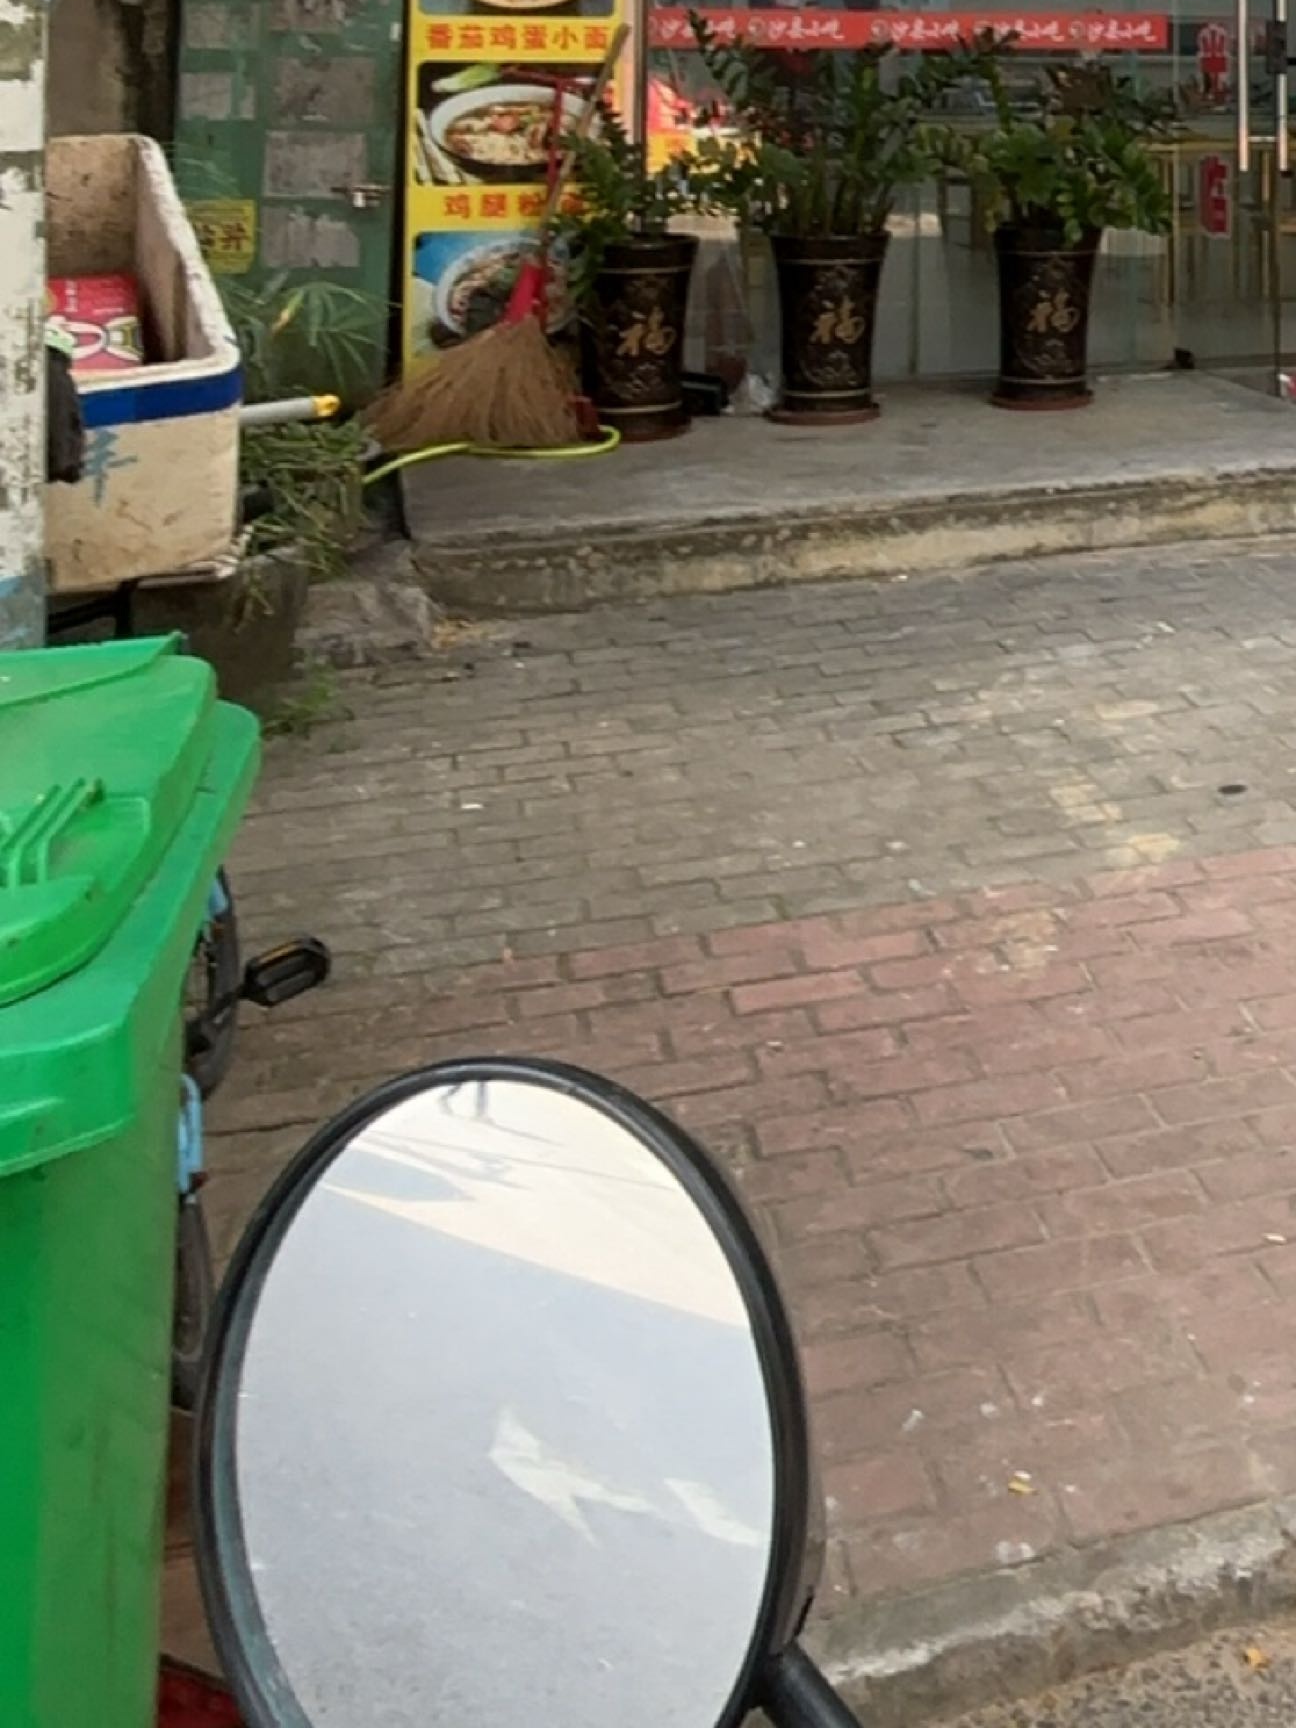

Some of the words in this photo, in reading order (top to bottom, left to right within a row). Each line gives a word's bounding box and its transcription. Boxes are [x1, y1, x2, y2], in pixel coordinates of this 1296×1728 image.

[426, 23, 611, 50] 番茄鸡蛋小面
